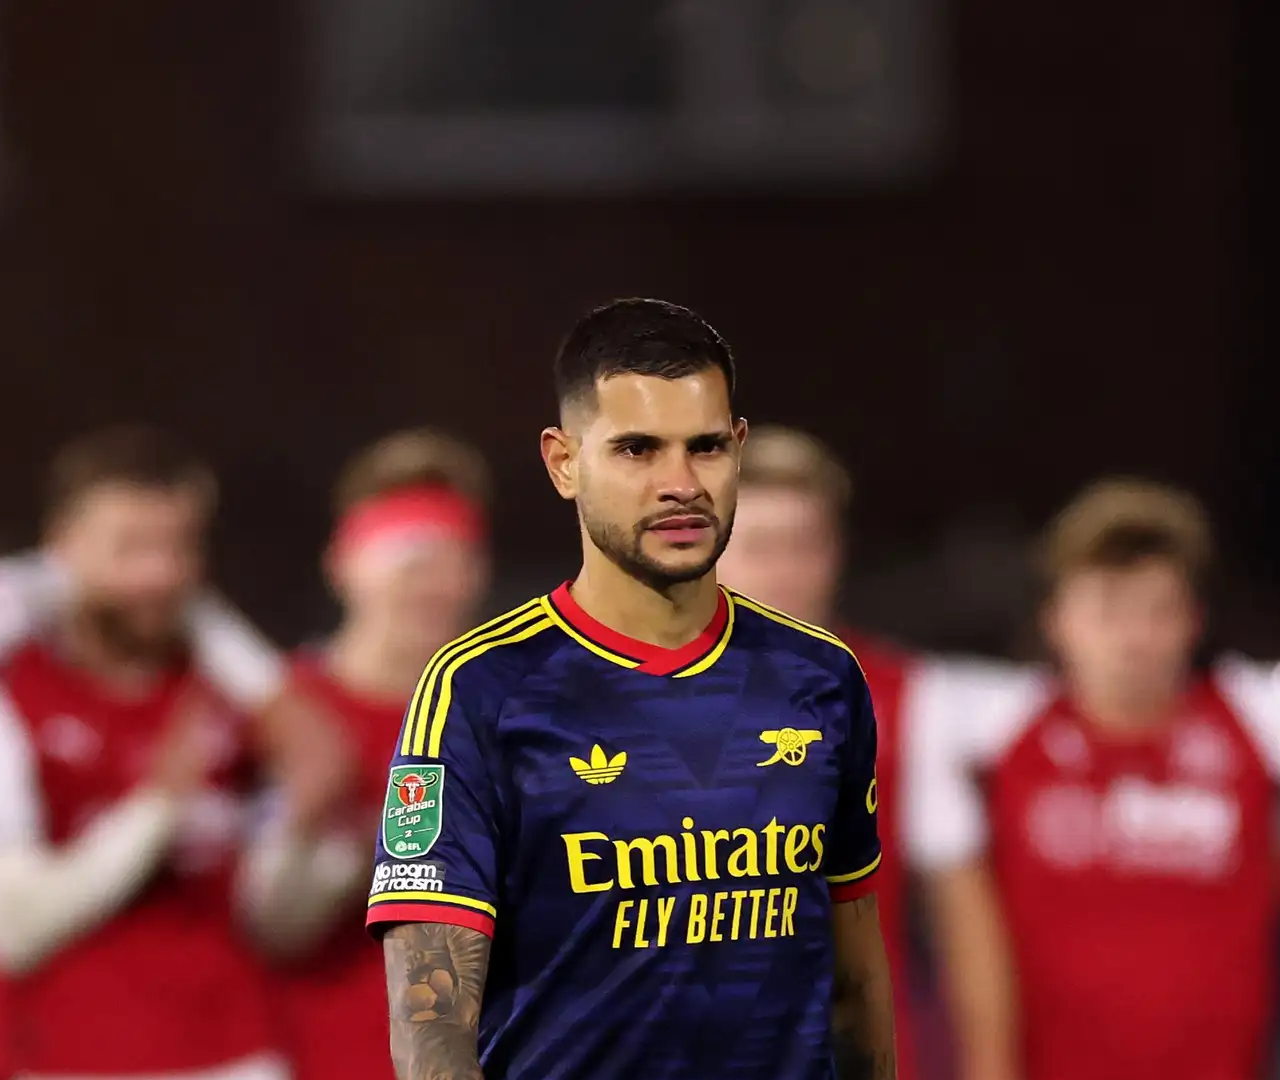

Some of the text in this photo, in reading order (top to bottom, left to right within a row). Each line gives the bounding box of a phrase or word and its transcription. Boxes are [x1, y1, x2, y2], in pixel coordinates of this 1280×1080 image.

[388, 799, 435, 818] Carabao
[397, 814, 421, 827] Cup
[404, 829, 413, 838] 2
[407, 842, 422, 851] EFL
[560, 816, 826, 894] Emirates
[375, 863, 437, 880] No room
[388, 876, 443, 892] racism
[612, 887, 798, 948] FLY BETTER
